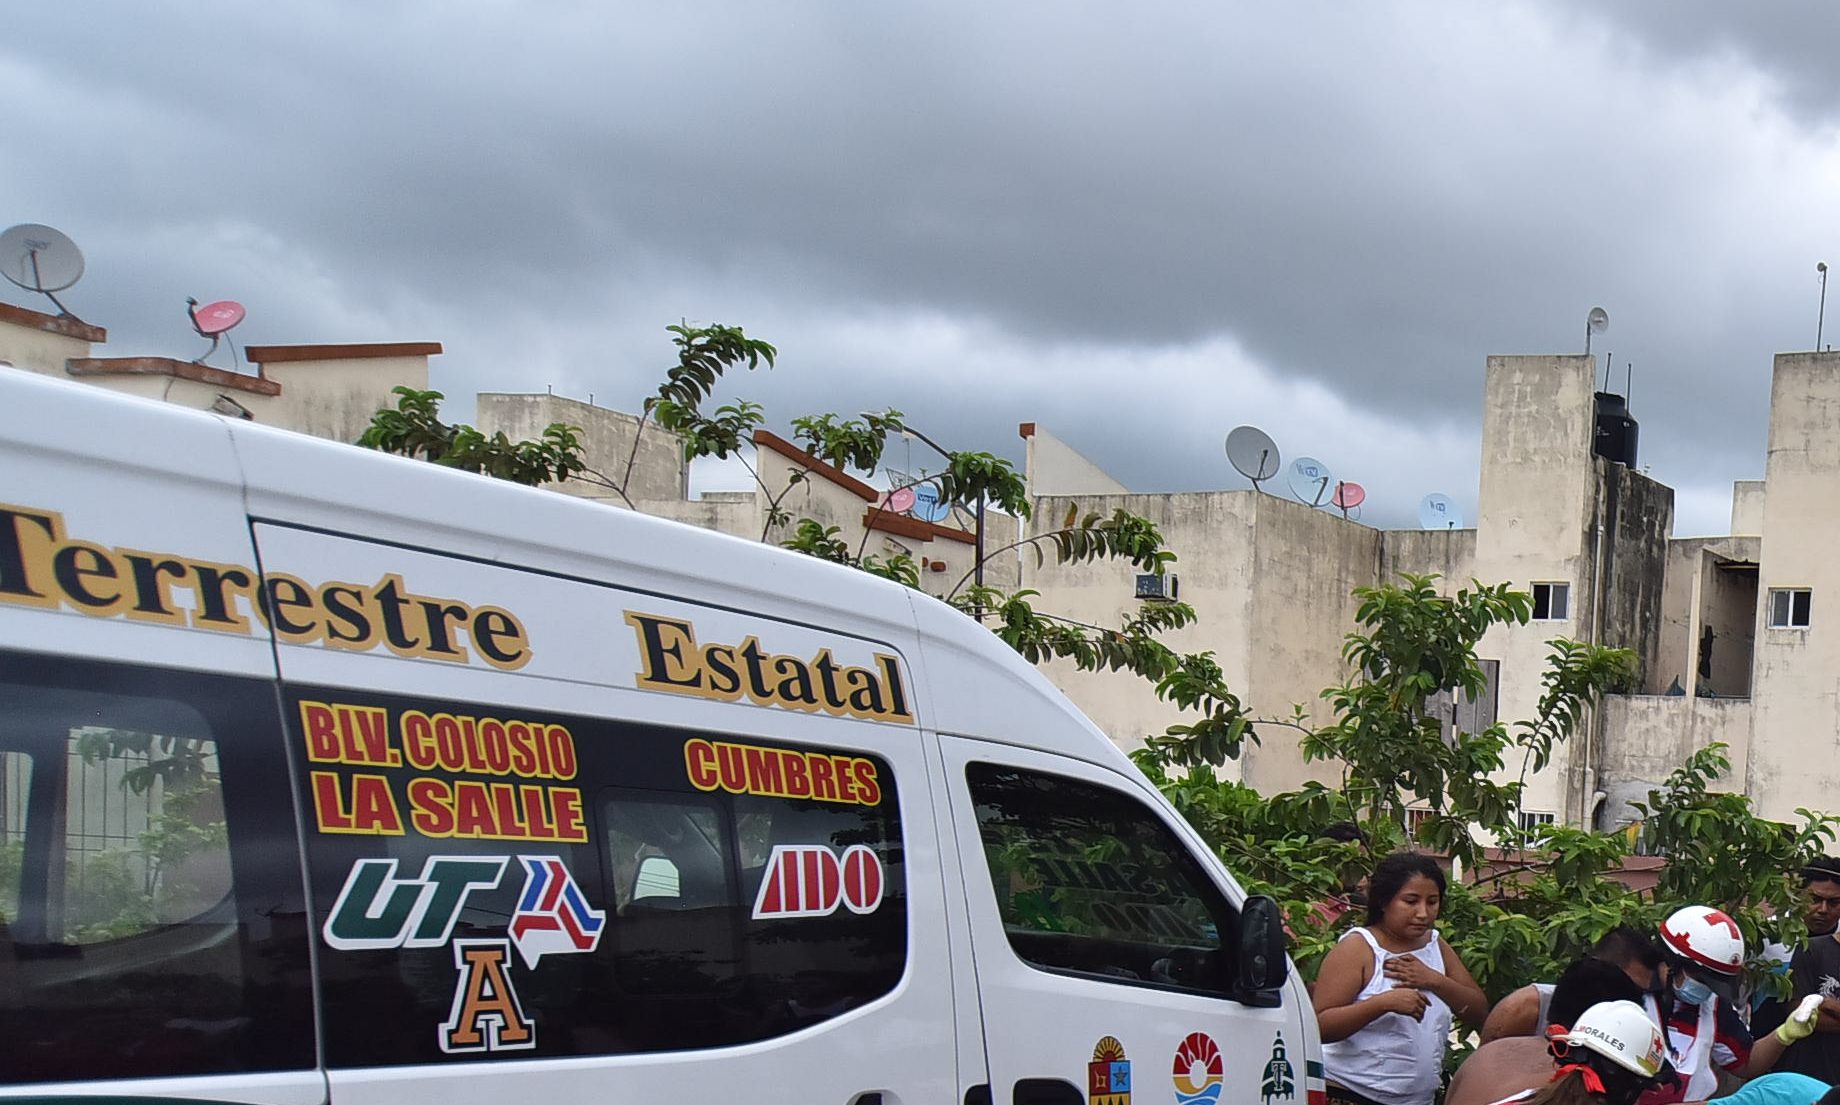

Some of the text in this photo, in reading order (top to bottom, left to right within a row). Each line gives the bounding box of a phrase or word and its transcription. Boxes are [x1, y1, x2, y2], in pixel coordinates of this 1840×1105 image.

[0, 503, 914, 725] Terrestre Estatal
[299, 700, 577, 780] BLV. COLOSIO
[684, 738, 881, 806] CUMBRES
[311, 771, 588, 843] LA SALLE
[752, 844, 884, 920] ADO
[438, 938, 536, 1053] A
